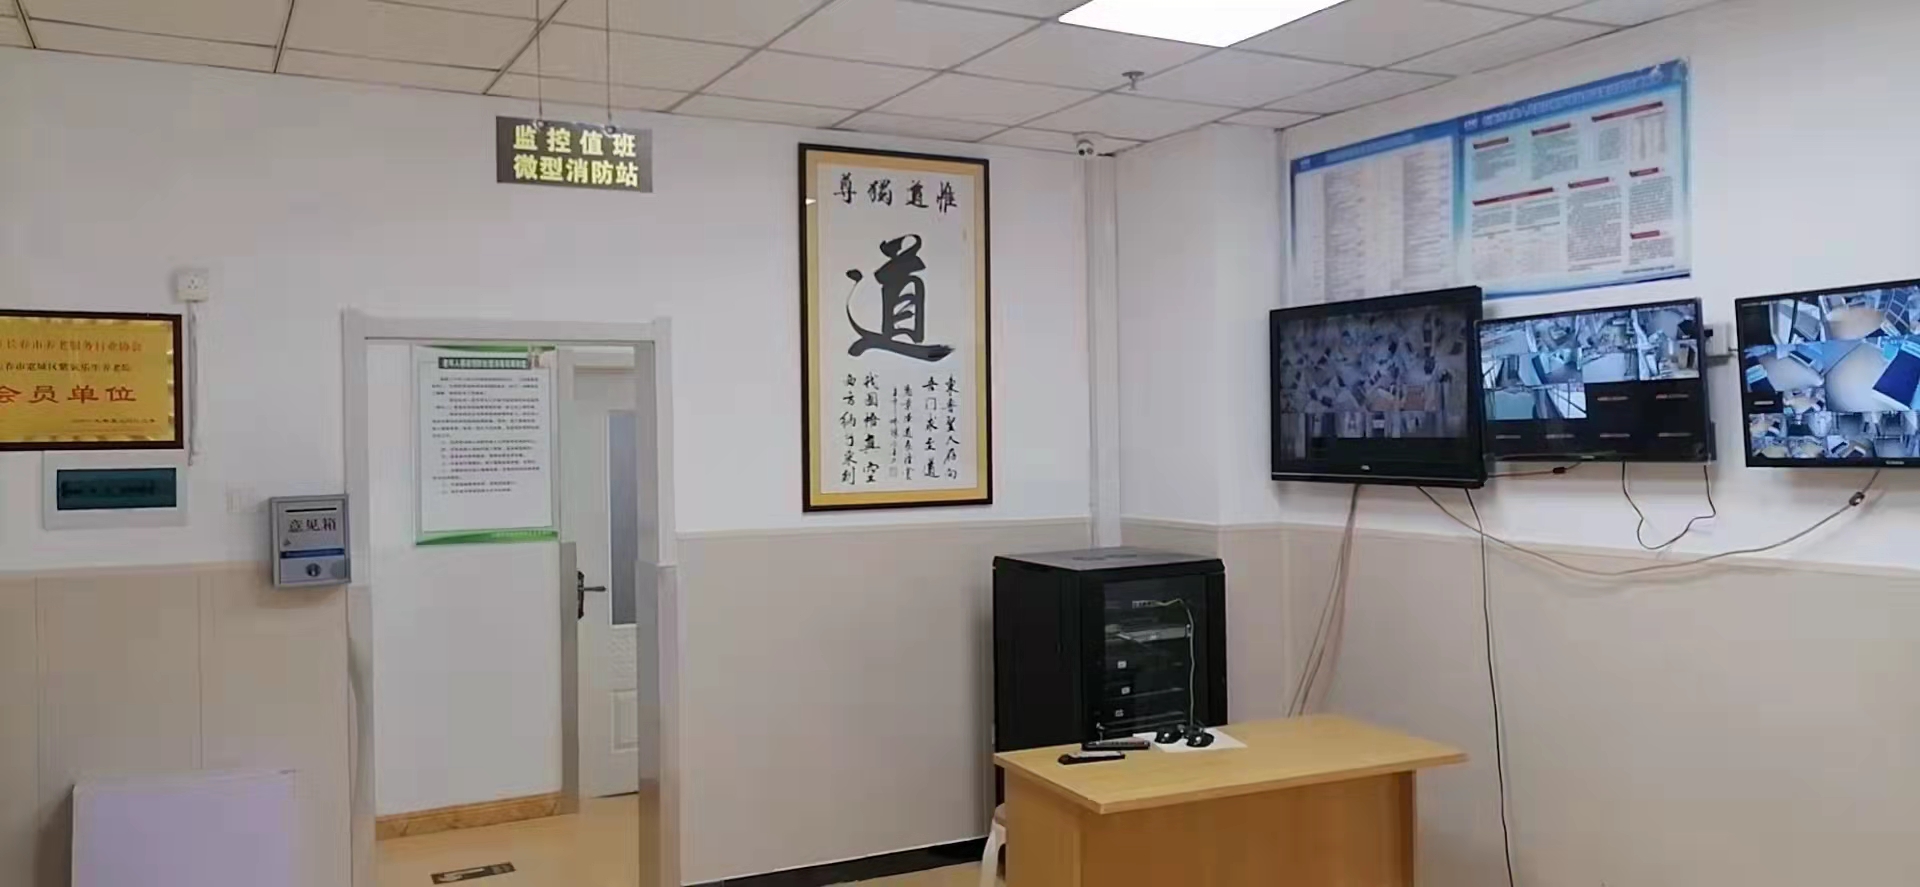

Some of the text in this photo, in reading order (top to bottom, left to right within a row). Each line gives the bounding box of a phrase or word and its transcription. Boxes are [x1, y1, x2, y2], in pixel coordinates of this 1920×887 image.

[513, 125, 637, 158] 监控值班
[513, 154, 639, 187] 微型消防站
[845, 233, 957, 362] 道
[0, 384, 137, 404] 会员单位
[287, 517, 337, 533] 意见箱
